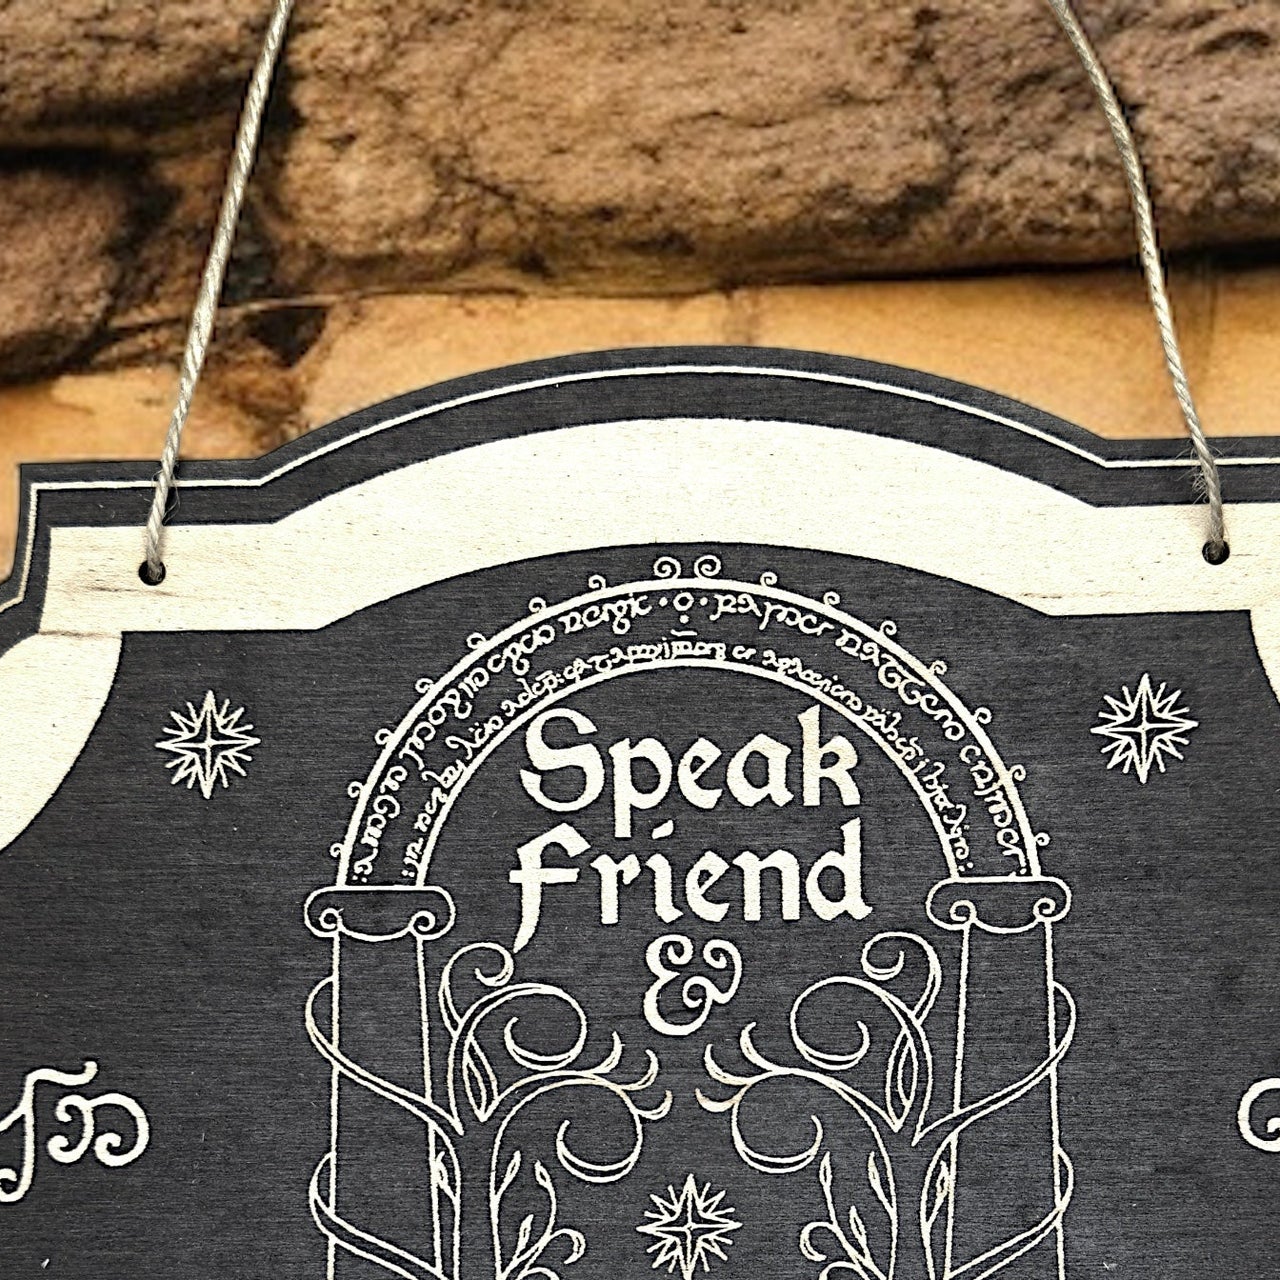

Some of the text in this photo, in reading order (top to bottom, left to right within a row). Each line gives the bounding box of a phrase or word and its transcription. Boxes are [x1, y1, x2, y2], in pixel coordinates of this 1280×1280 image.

[520, 708, 860, 838] Speak
[511, 820, 872, 952] Friend
[645, 935, 741, 1034] &
